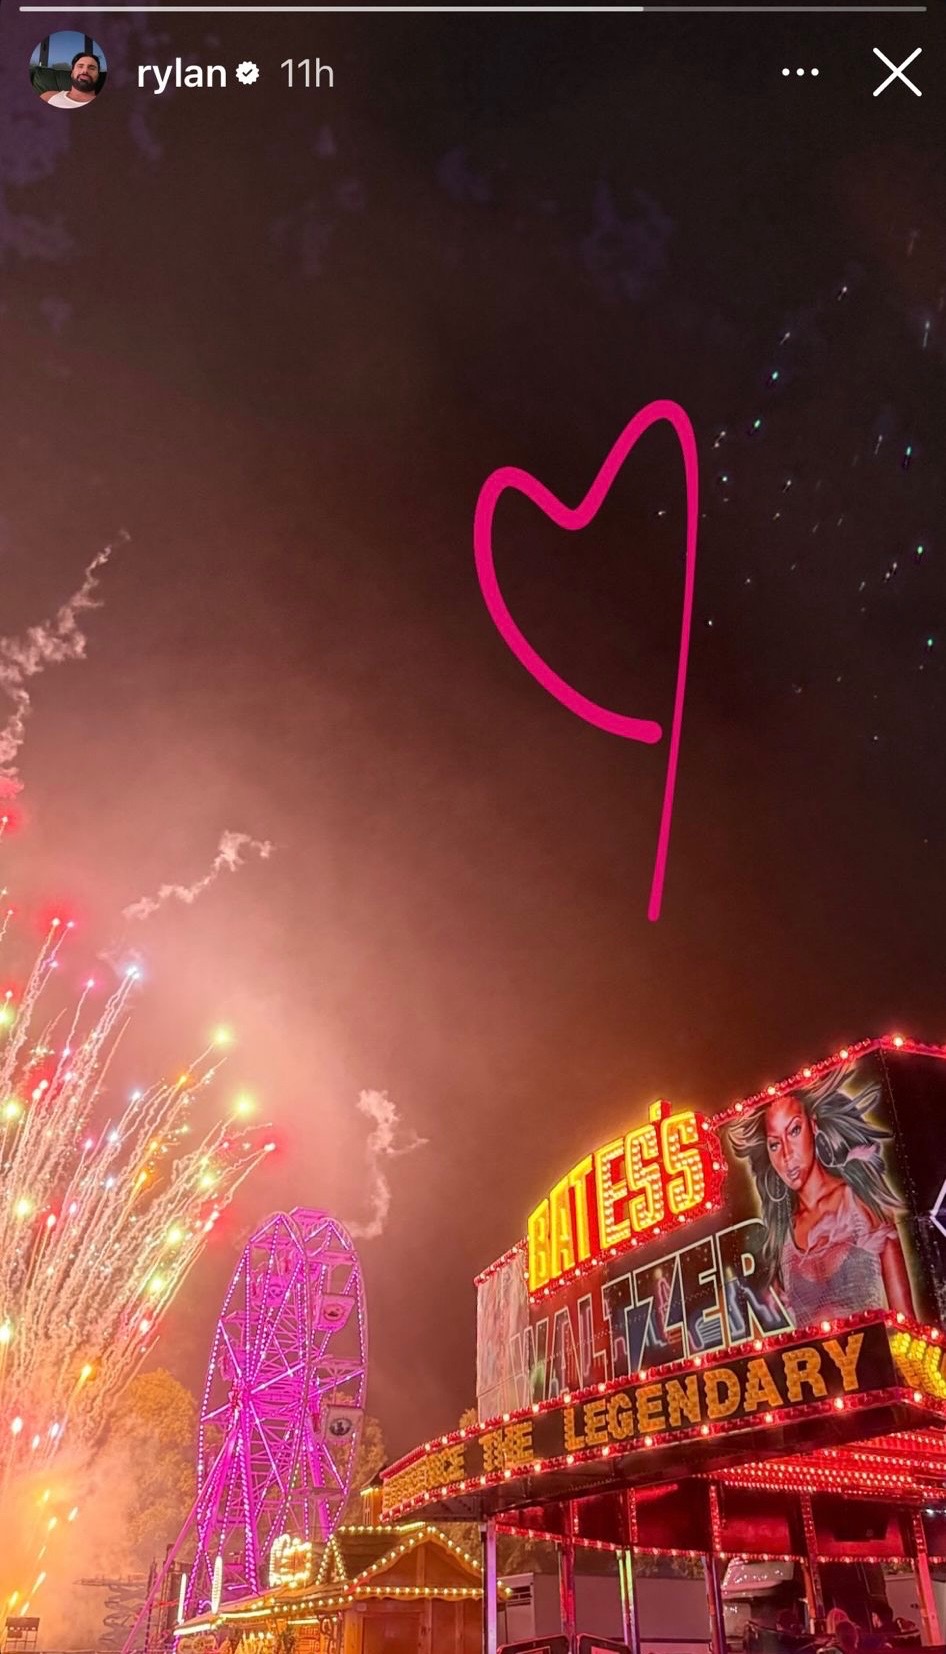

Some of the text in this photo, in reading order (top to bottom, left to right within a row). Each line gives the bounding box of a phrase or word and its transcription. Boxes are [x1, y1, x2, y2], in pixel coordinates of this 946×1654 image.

[527, 1100, 706, 1292] BATES'S
[509, 1218, 796, 1406] WALTZER
[562, 1332, 866, 1452] LEGENDARY
